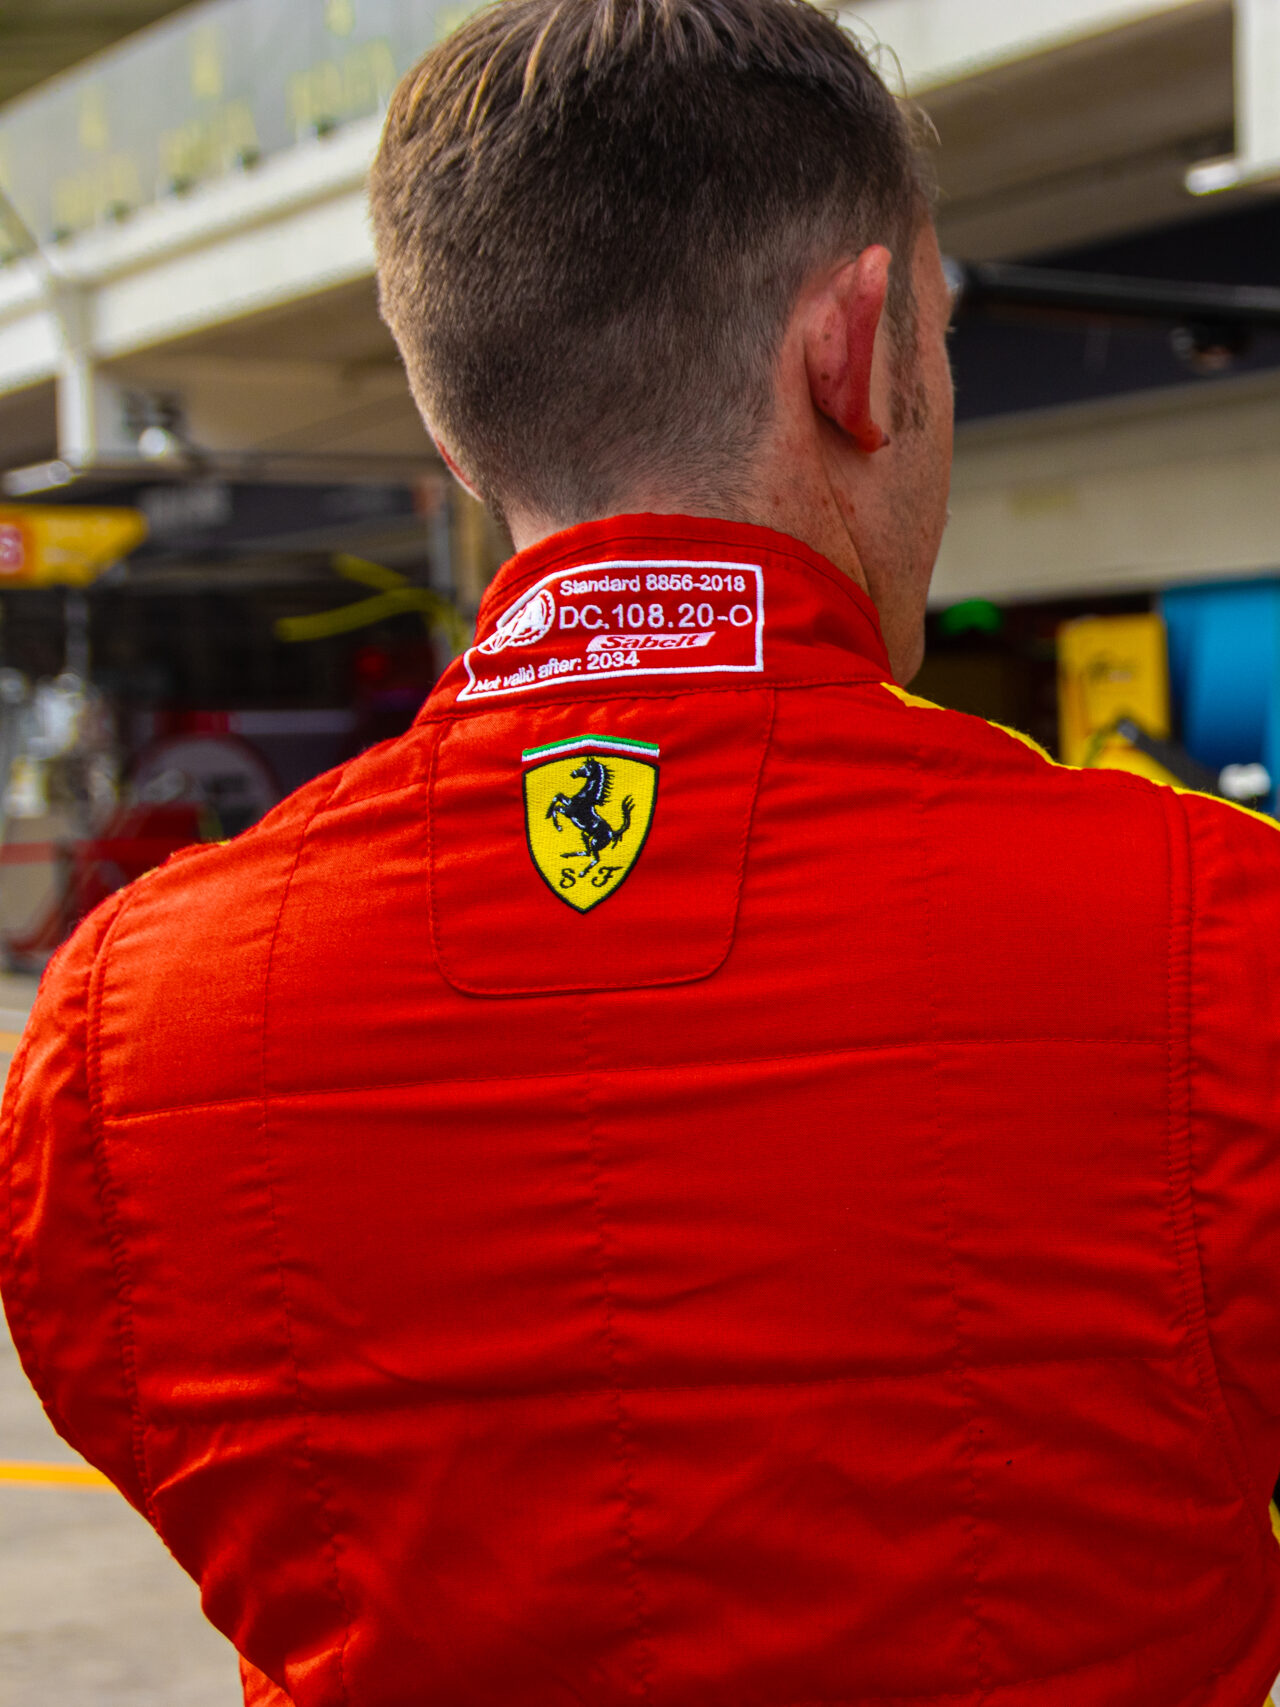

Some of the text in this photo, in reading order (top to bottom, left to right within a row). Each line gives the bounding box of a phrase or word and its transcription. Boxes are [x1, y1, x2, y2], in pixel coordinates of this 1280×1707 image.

[559, 574, 746, 596] Standard 8856-2018
[600, 634, 699, 650] Sabelt
[472, 650, 641, 692] Not valid after: 2034
